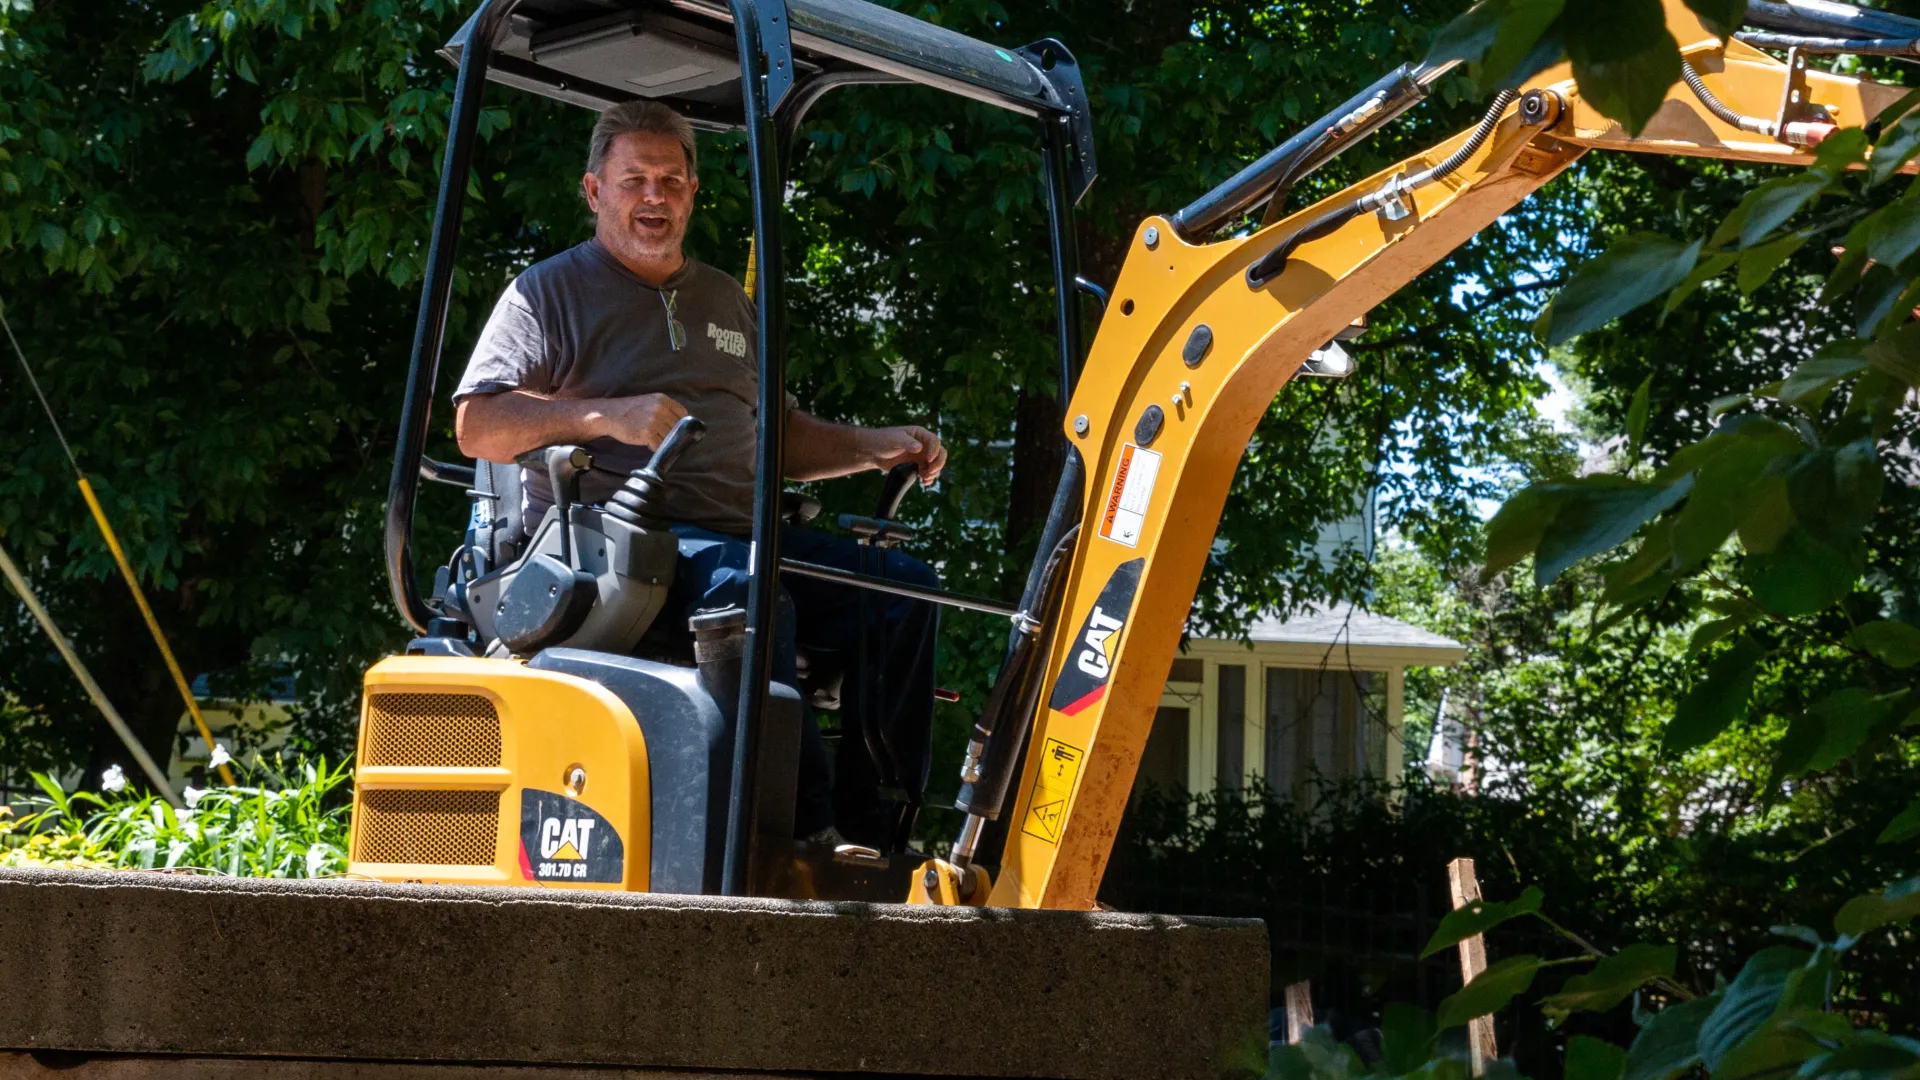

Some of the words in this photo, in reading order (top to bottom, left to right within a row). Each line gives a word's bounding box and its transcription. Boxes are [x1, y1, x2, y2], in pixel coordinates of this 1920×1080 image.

[715, 338, 747, 358] PLUS!
[1109, 458, 1130, 512] WARNING
[1077, 605, 1123, 679] CAT
[540, 817, 595, 860] CAT
[538, 862, 571, 878] 301.7D
[572, 863, 587, 878] CR
